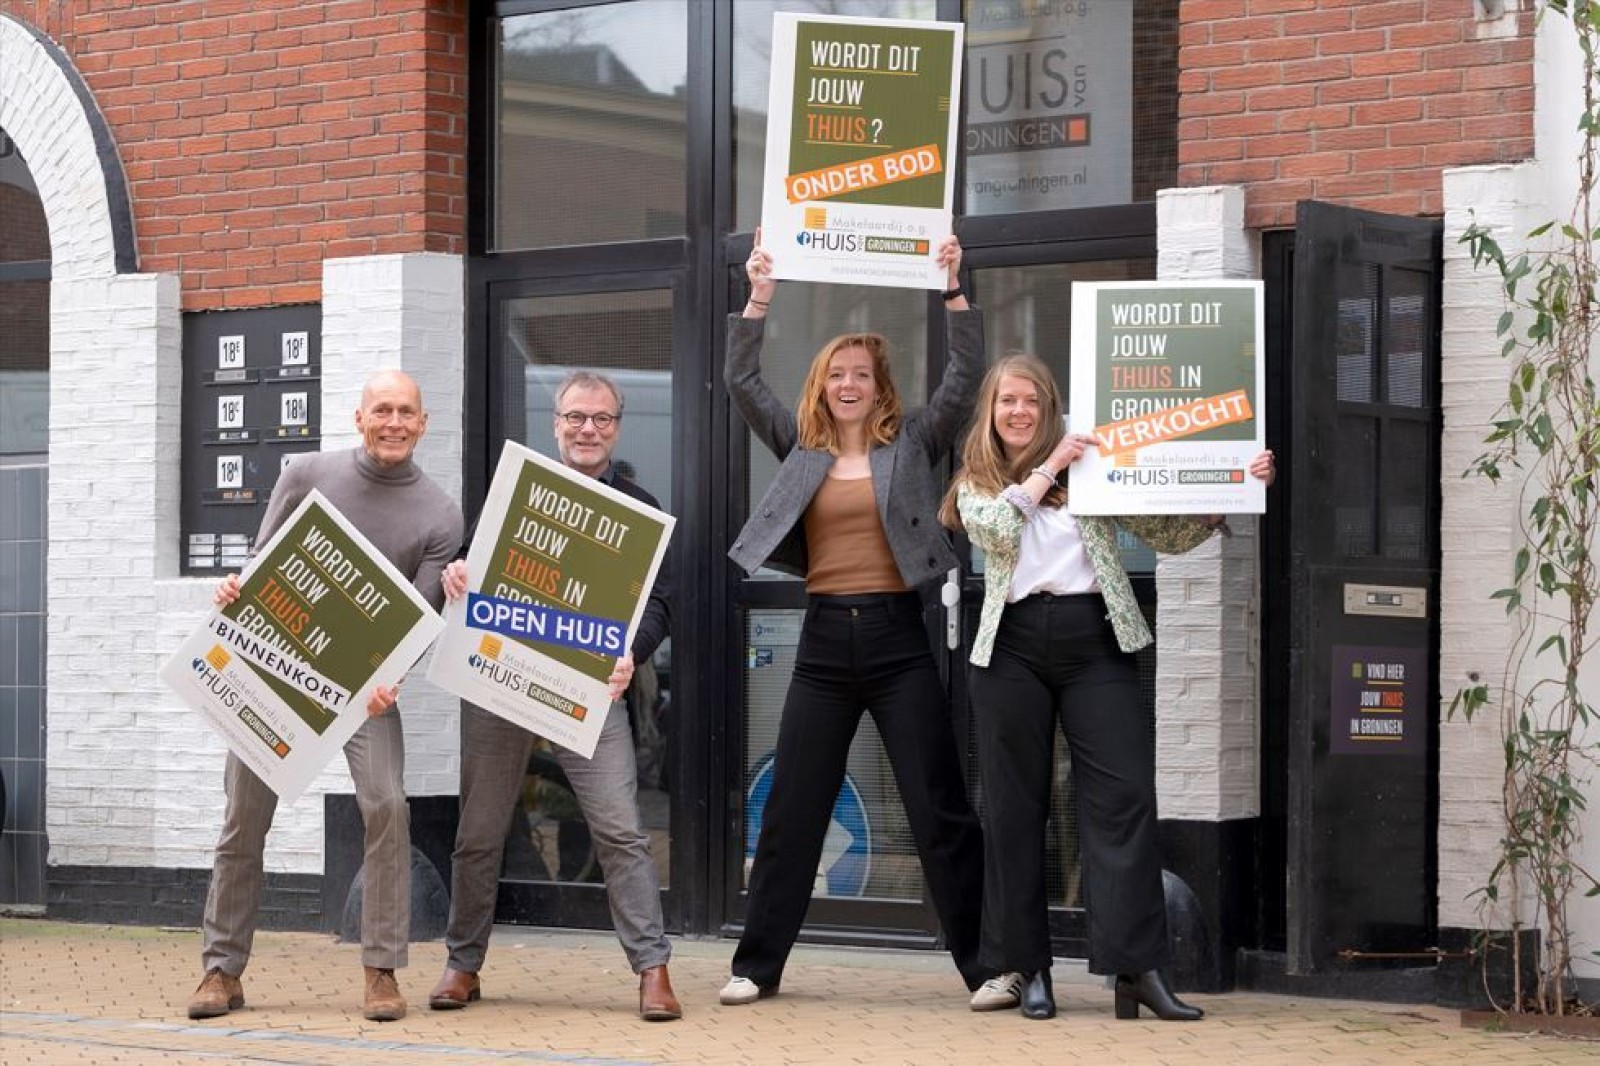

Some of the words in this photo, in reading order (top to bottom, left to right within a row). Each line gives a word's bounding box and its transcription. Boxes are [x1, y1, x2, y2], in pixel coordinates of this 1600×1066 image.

[811, 40, 882, 70] WORDT
[888, 45, 922, 72] DIT
[807, 78, 865, 106] JOUW
[968, 48, 1070, 115] UIS
[1073, 64, 1087, 108] van
[807, 113, 868, 143] THUIS
[871, 118, 884, 144] ?
[966, 119, 1066, 151] ONINGEN
[792, 162, 879, 201] ONDER
[883, 150, 936, 181] BOD
[812, 232, 857, 252] HUIS
[867, 238, 916, 252] GRONINGEN
[1111, 303, 1183, 326] WORDT
[1190, 302, 1223, 325] DIT
[1110, 334, 1168, 357] JOUW
[1110, 365, 1173, 389] THUIS
[1179, 365, 1202, 388] IN
[1096, 394, 1246, 451] VERKOCHT
[1122, 469, 1170, 486] HUIS
[1180, 471, 1231, 483] GRONINGEN
[528, 482, 595, 533] WORDT
[596, 517, 630, 549] DIT
[513, 516, 570, 559] JOUW
[277, 552, 331, 605] JOUW
[302, 524, 363, 588] WORDT
[355, 580, 391, 618] DIT
[504, 548, 562, 595] THUIS
[562, 577, 588, 608] IN
[257, 577, 311, 636] THUIS
[304, 625, 333, 656] IN
[472, 599, 548, 636] OPEN
[556, 616, 622, 650] HUIS
[216, 621, 345, 706] BINNENKORT
[479, 658, 523, 692] HUIS
[1367, 663, 1386, 679] VIND
[1387, 663, 1405, 680] HIER
[199, 667, 239, 708] HUIS
[530, 683, 575, 716] GRONINGEN
[1360, 691, 1381, 706] JOUW
[1382, 691, 1404, 707] THUIS
[241, 709, 279, 748] GRONINGEN
[1351, 718, 1360, 734] IN
[1361, 718, 1403, 735] GRONINGEN
